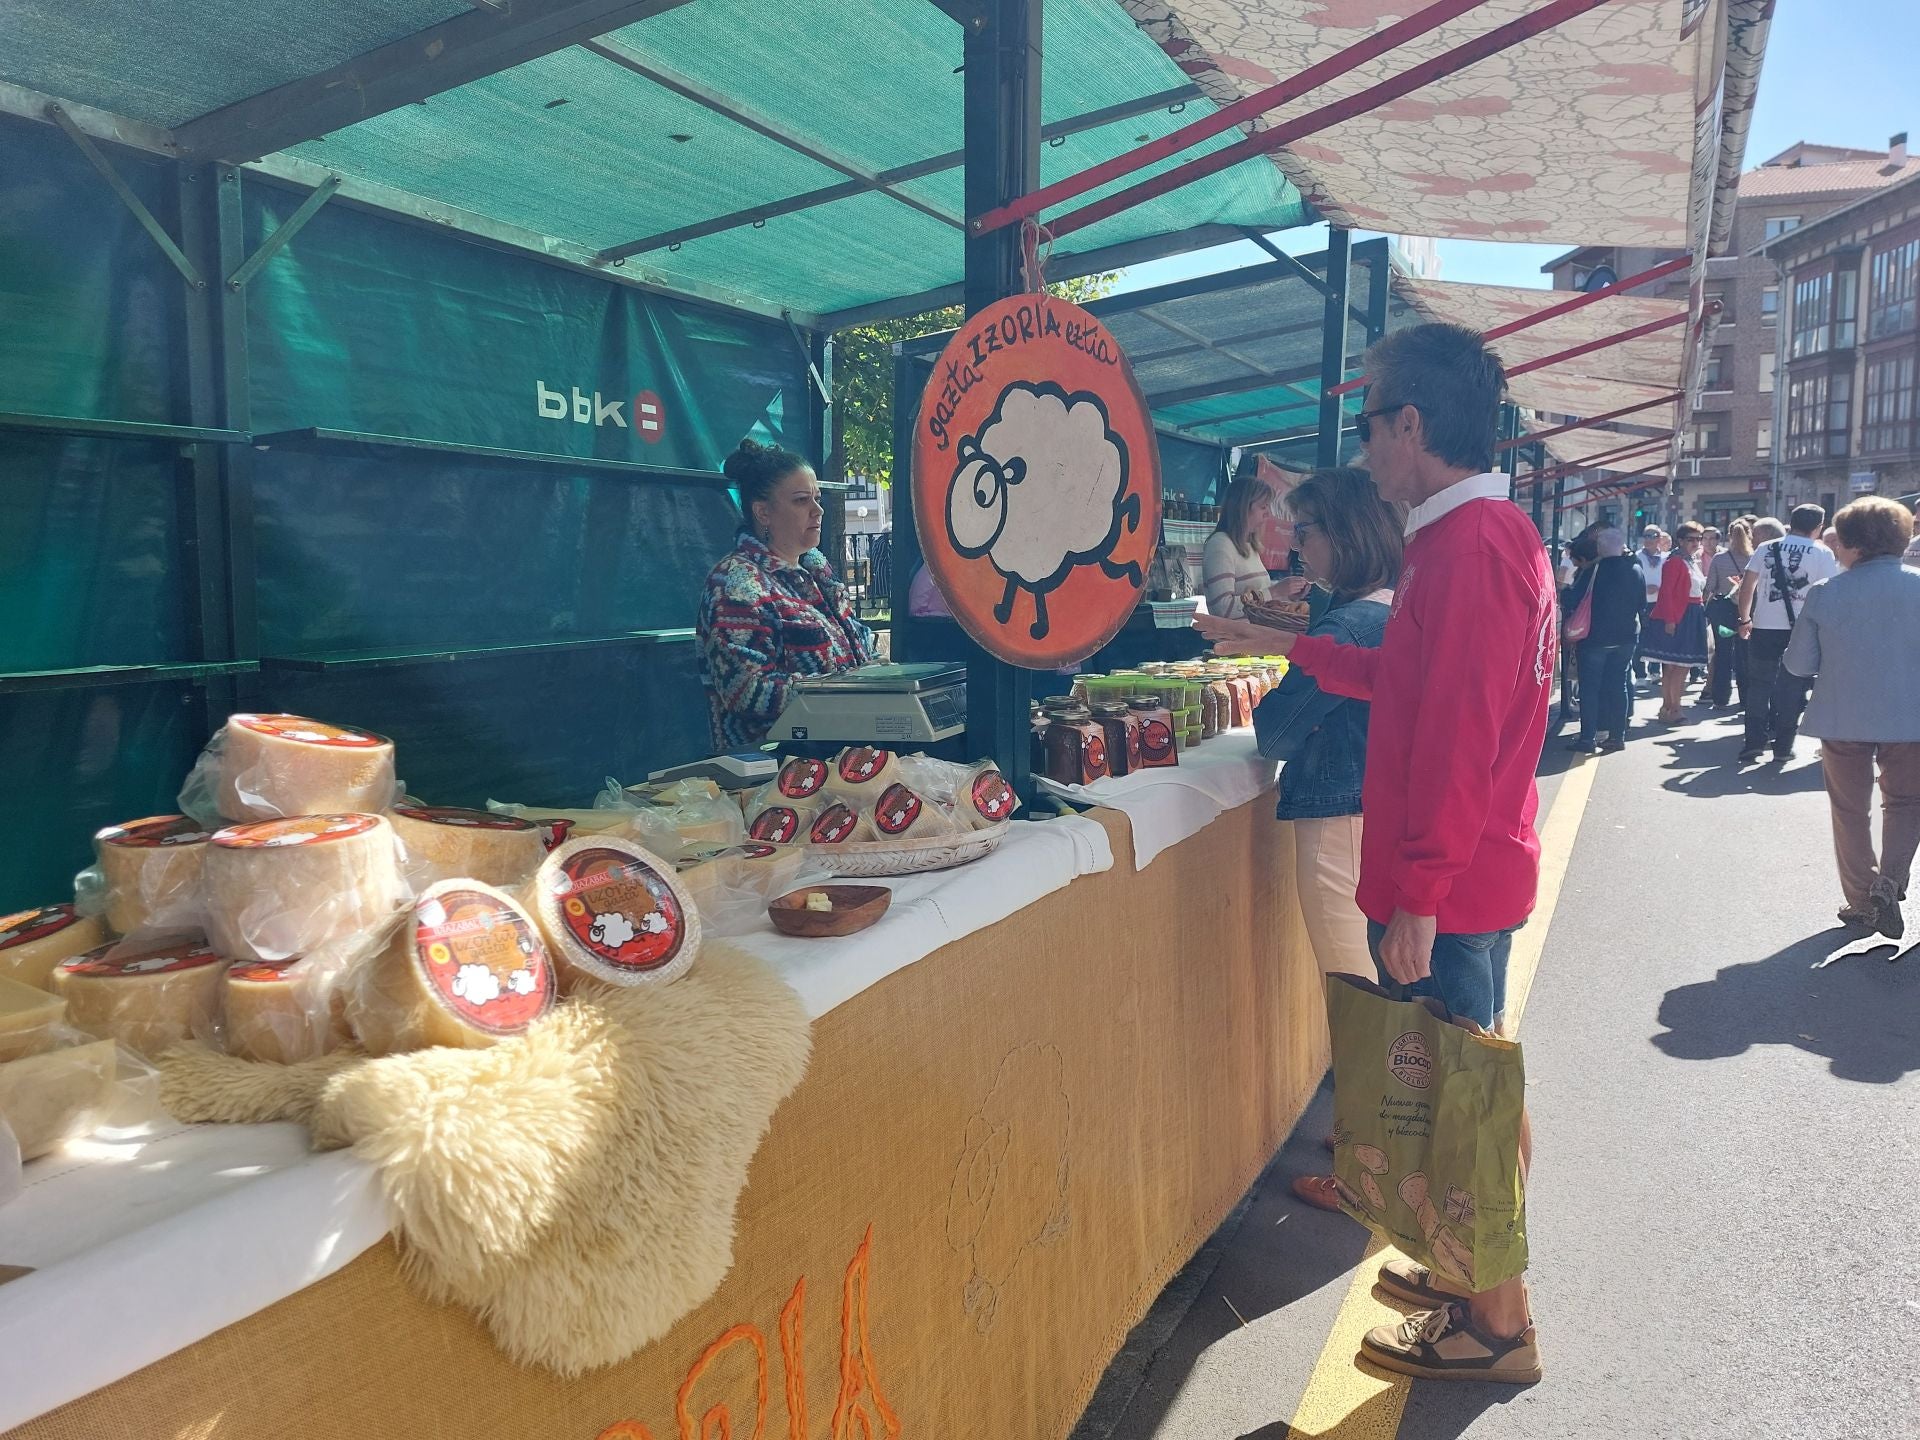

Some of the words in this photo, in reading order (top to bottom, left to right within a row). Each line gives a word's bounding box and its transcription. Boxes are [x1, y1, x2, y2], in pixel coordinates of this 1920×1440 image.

[928, 358, 982, 450] gazta
[968, 304, 1061, 367] IZORIA
[1065, 318, 1117, 365] eztia
[536, 380, 627, 428] bbk
[1380, 1110, 1389, 1119] de
[1381, 1095, 1413, 1106] Nueva
